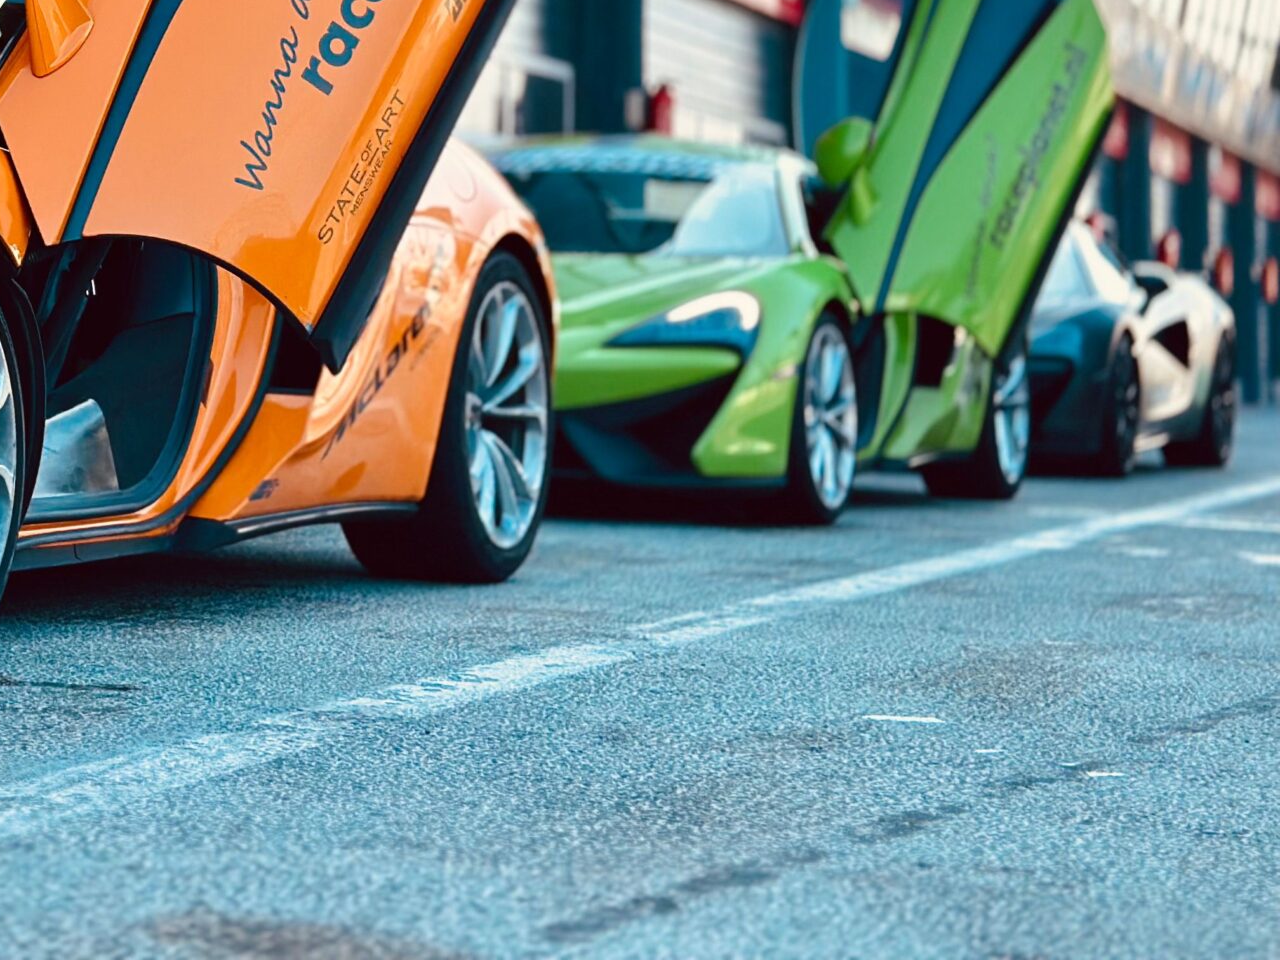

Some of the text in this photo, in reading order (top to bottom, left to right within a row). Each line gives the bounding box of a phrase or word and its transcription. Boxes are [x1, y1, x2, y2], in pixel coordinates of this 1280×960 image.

[234, 25, 299, 191] Wanna
[317, 88, 406, 245] STATE OF ART
[349, 139, 393, 216] MENSWEAR
